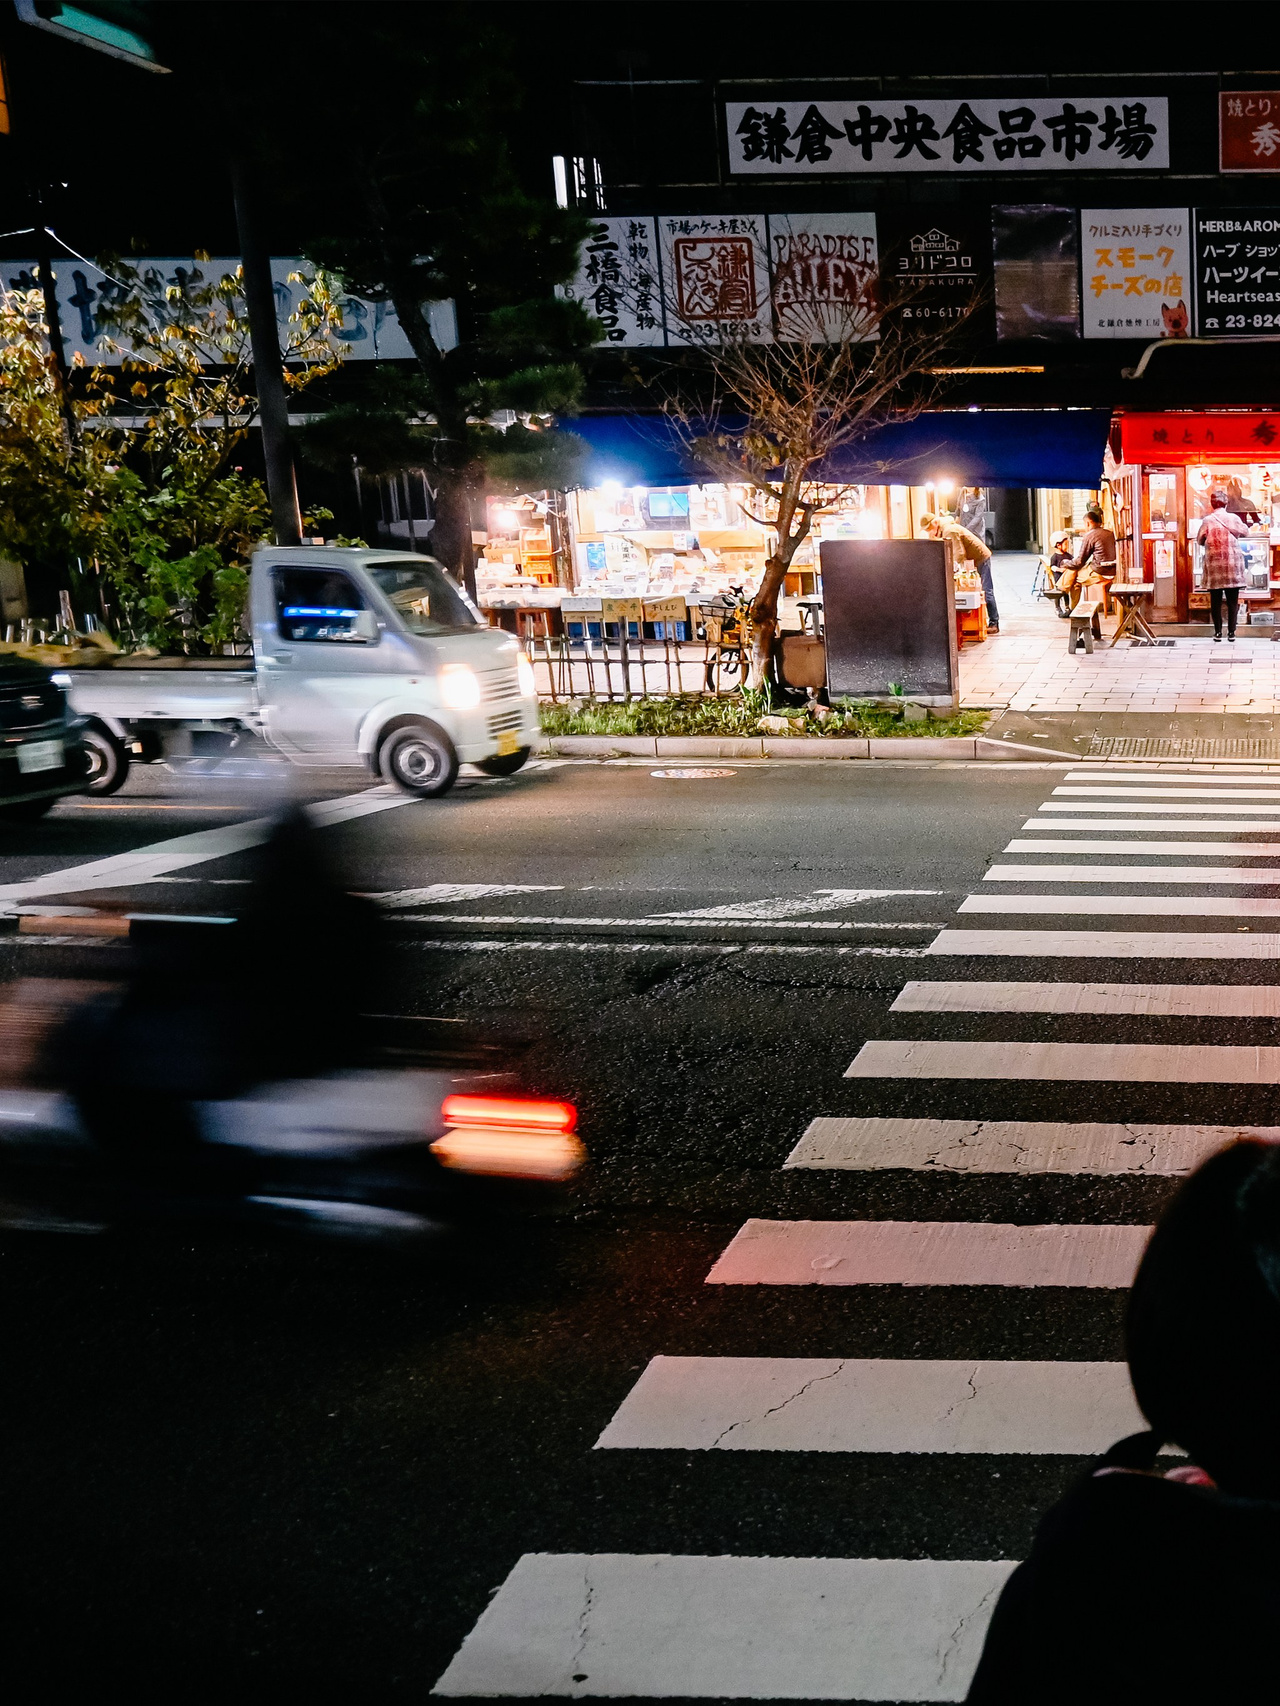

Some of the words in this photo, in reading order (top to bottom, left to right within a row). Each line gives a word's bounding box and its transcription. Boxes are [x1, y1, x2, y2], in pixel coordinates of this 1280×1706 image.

[736, 102, 1157, 164] 鎌倉中央食品市場
[667, 219, 759, 235] 市場のケーキ屋さん
[1089, 224, 1182, 238] クルミ入り手づくり
[774, 233, 874, 263] PARADISE
[1095, 246, 1175, 268] スモーク
[1203, 242, 1241, 258] ハーブ
[899, 254, 972, 270] ヨリドコロ
[585, 223, 628, 342] 三橋食品
[1090, 271, 1183, 298] チーズの店
[1153, 428, 1215, 445] 焼とり
